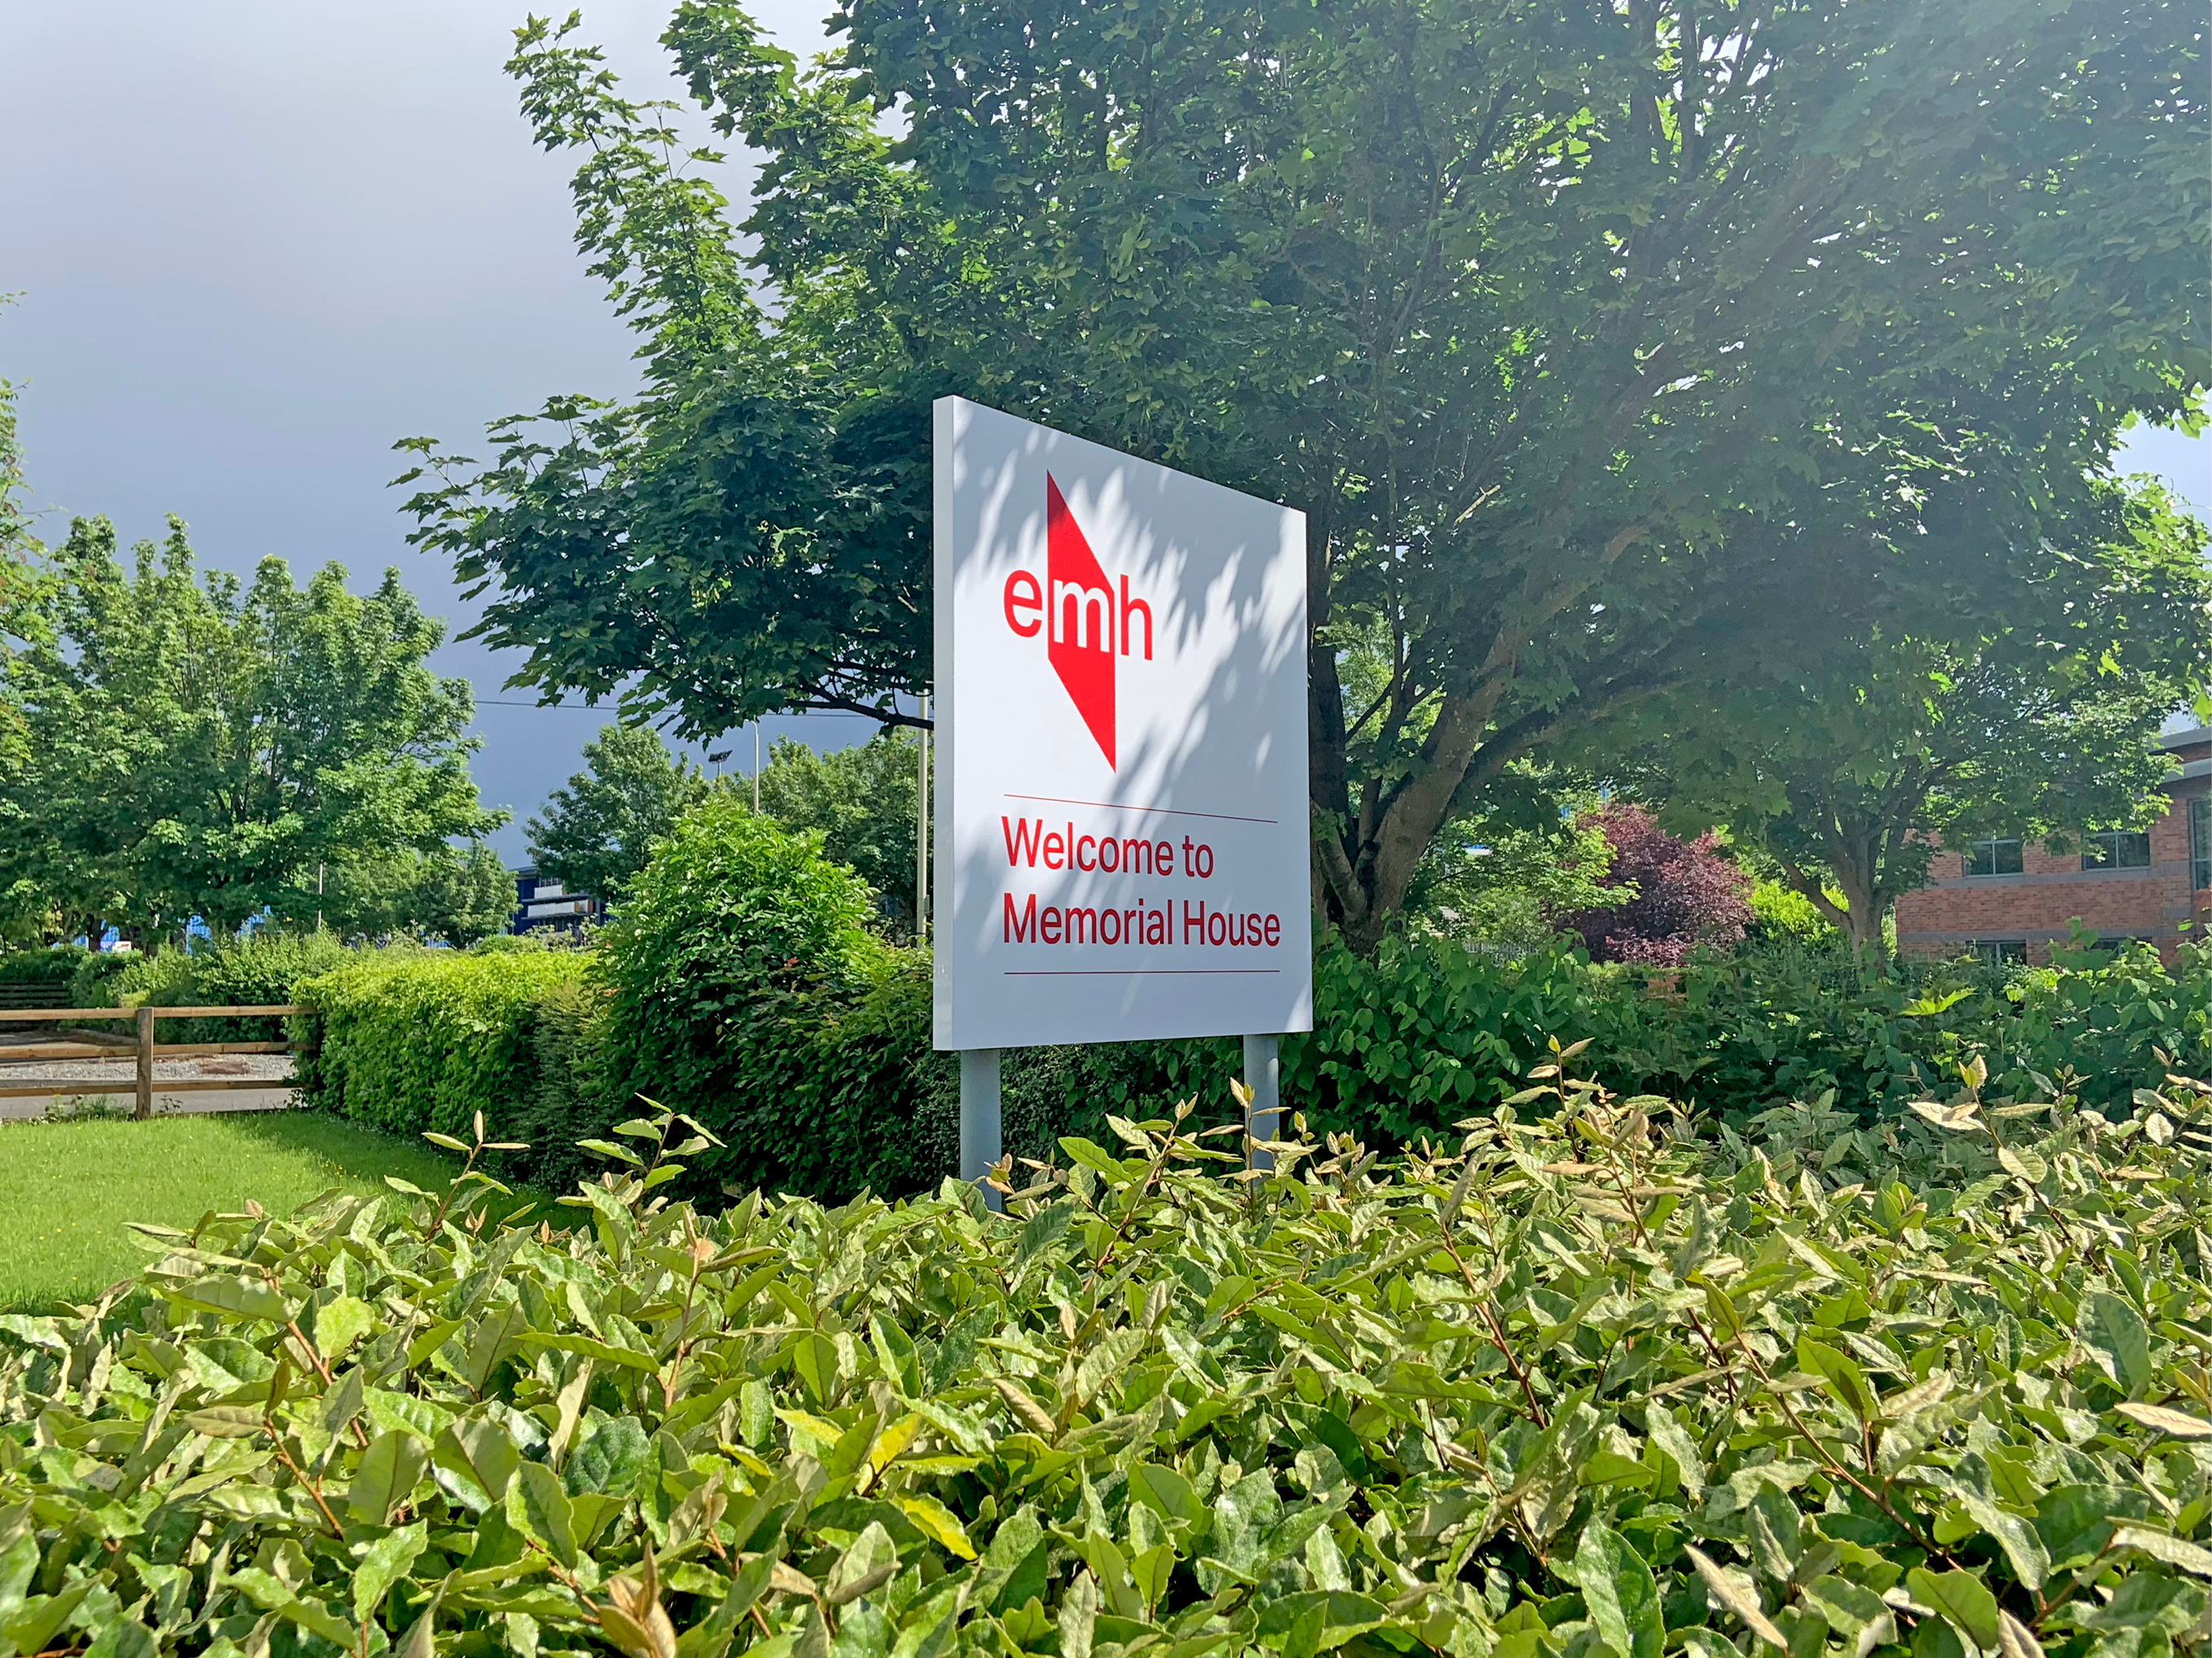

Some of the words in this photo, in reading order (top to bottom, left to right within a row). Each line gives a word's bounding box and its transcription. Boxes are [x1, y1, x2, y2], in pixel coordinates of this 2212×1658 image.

[1004, 570, 1153, 661] emh
[1002, 816, 1174, 877] Welcome
[1182, 835, 1214, 878] to
[1004, 893, 1172, 946] Memorial
[1184, 900, 1281, 947] House
